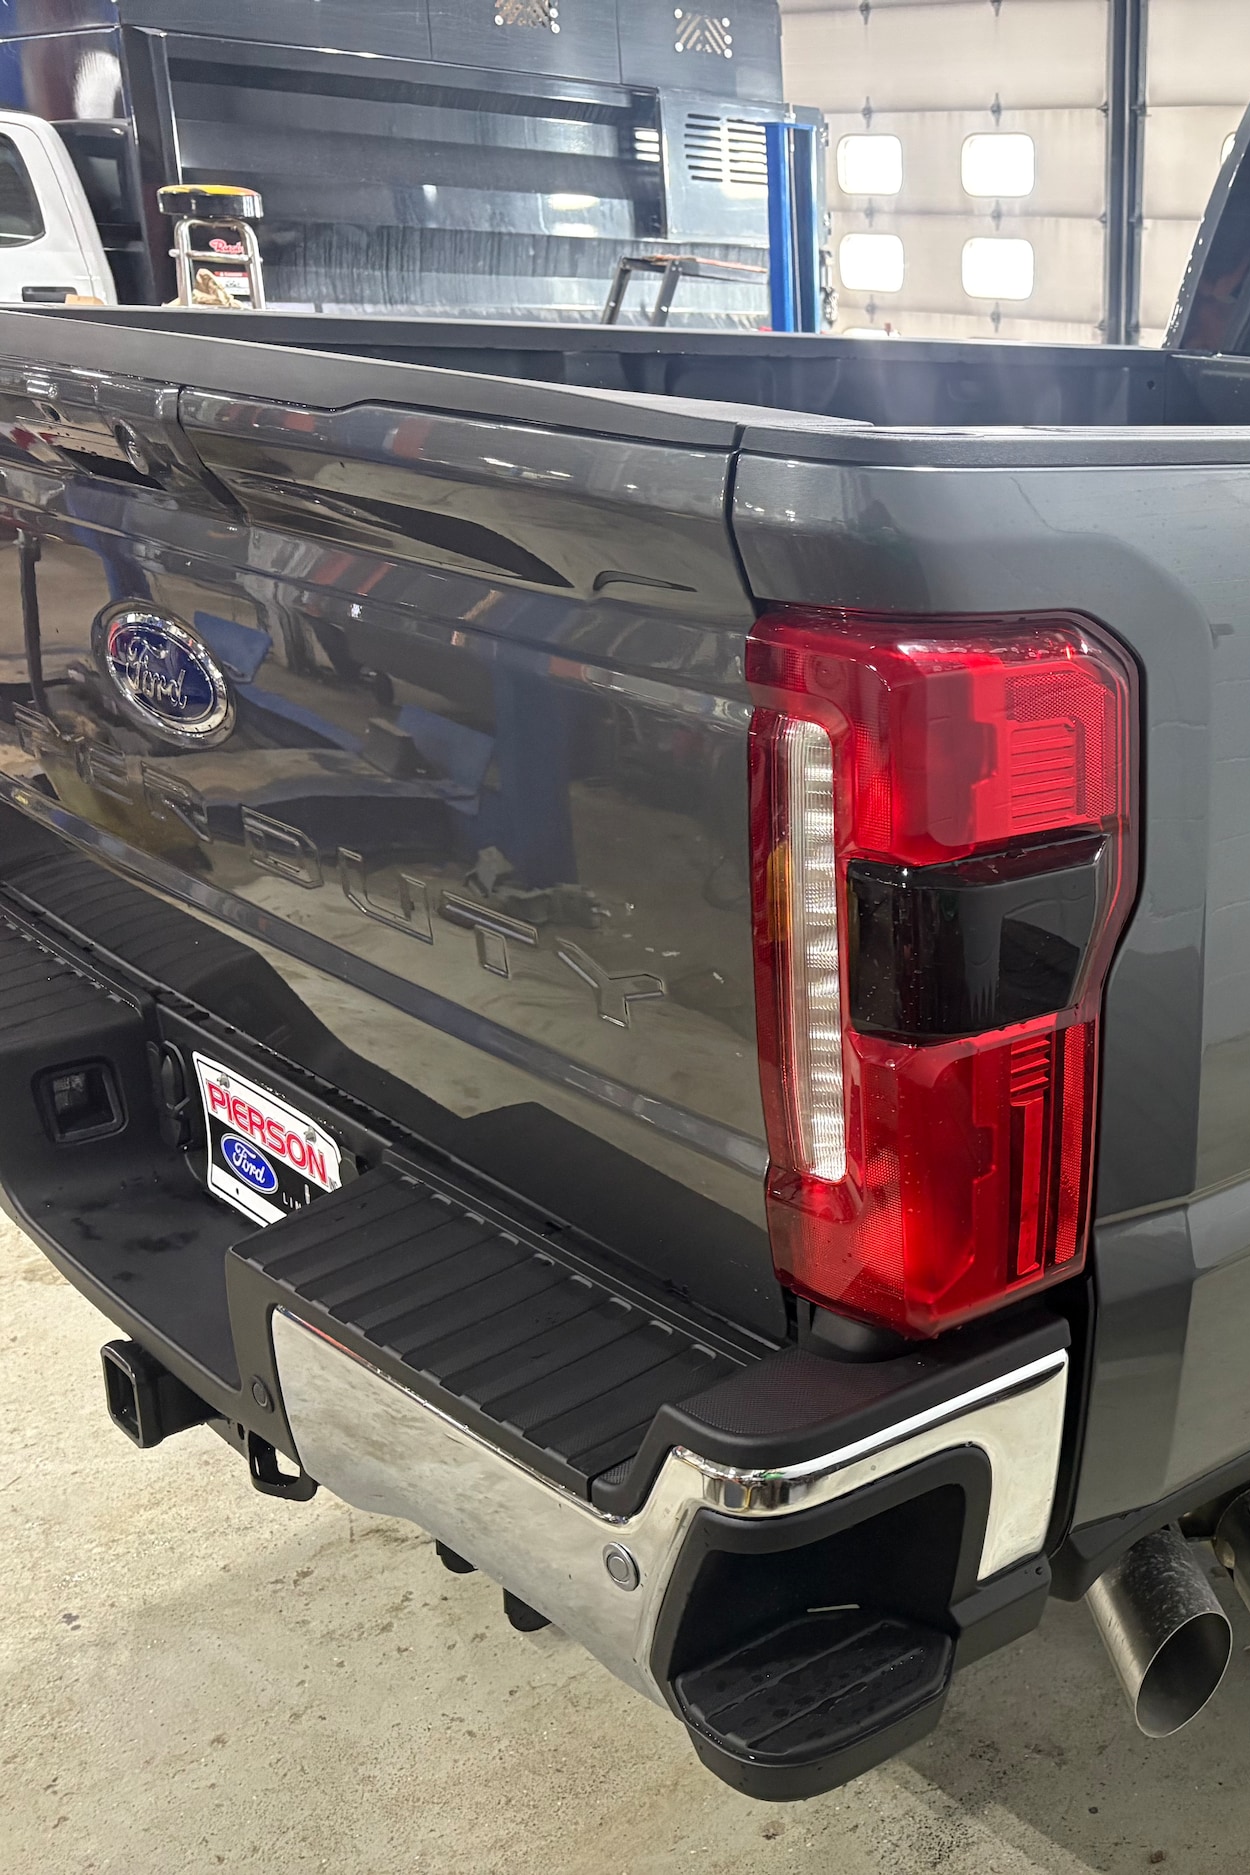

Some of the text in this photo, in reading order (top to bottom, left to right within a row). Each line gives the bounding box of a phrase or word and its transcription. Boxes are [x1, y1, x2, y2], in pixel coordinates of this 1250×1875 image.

[125, 636, 188, 709] Ford
[240, 804, 665, 1029] DUTY
[206, 1080, 330, 1189] PIERSON
[232, 1142, 266, 1184] Ford
